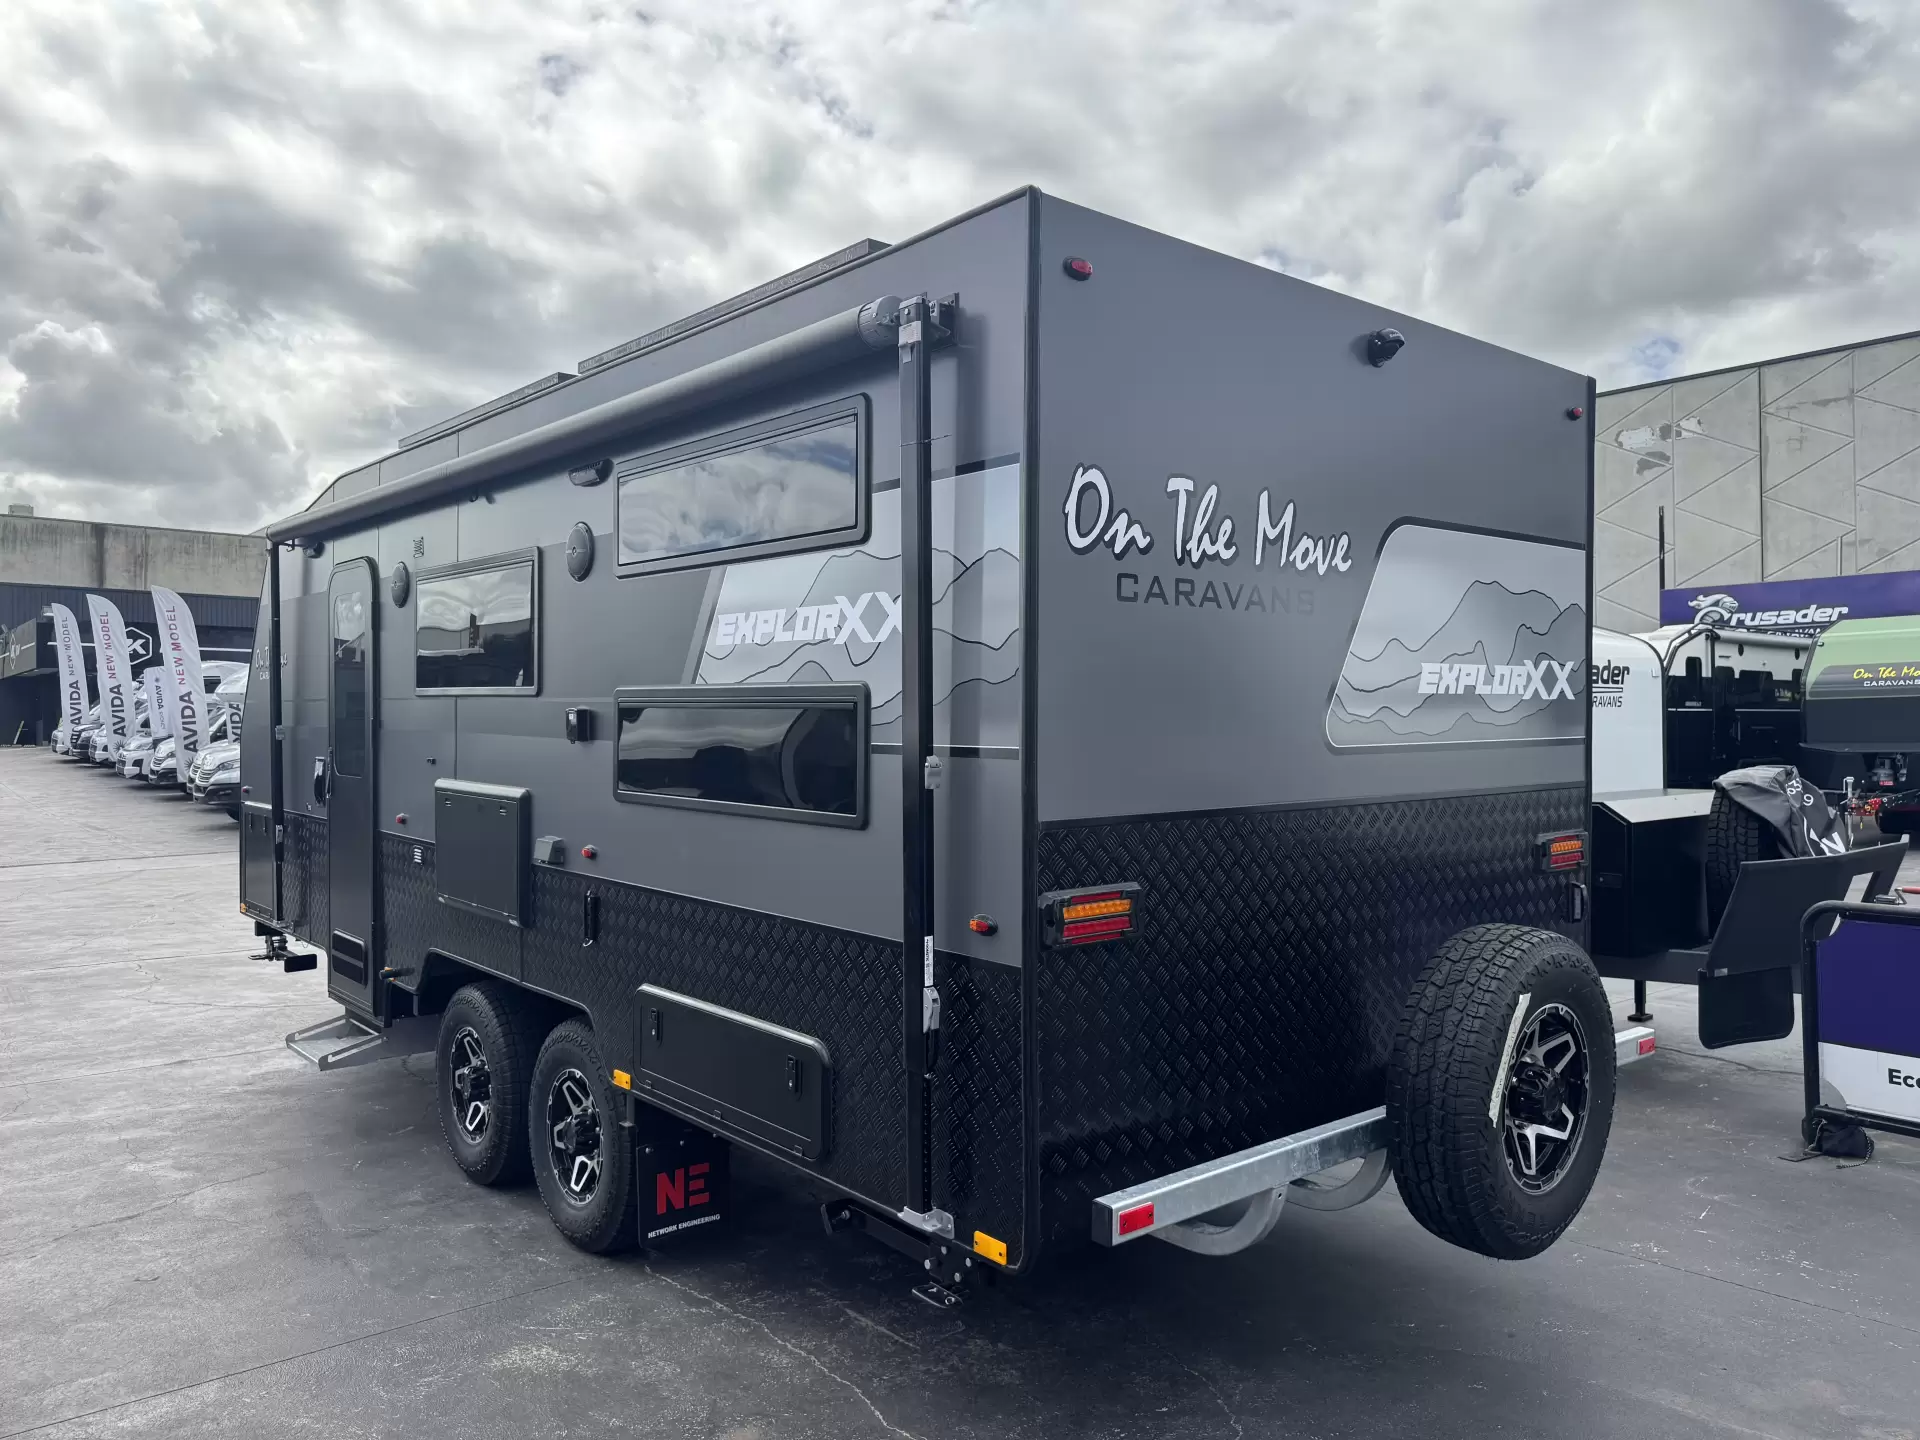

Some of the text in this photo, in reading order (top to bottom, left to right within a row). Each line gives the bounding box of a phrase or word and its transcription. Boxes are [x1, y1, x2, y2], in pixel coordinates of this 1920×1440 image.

[1063, 463, 1353, 577] On The Move
[1116, 572, 1315, 615] CARAVANS
[61, 616, 83, 726] AVIDA NEW MODEL
[100, 611, 127, 737] AVIDA NEW MODEL
[165, 605, 199, 753] AVIDA NEW MODEL
[1418, 659, 1576, 700] EXPLORXX
[1592, 659, 1630, 685] ader
[1853, 665, 1920, 679] On The Mo
[1592, 695, 1623, 708] RAVANS
[656, 1162, 710, 1216] NE
[648, 1213, 721, 1239] NETWORK ENGINEERING
